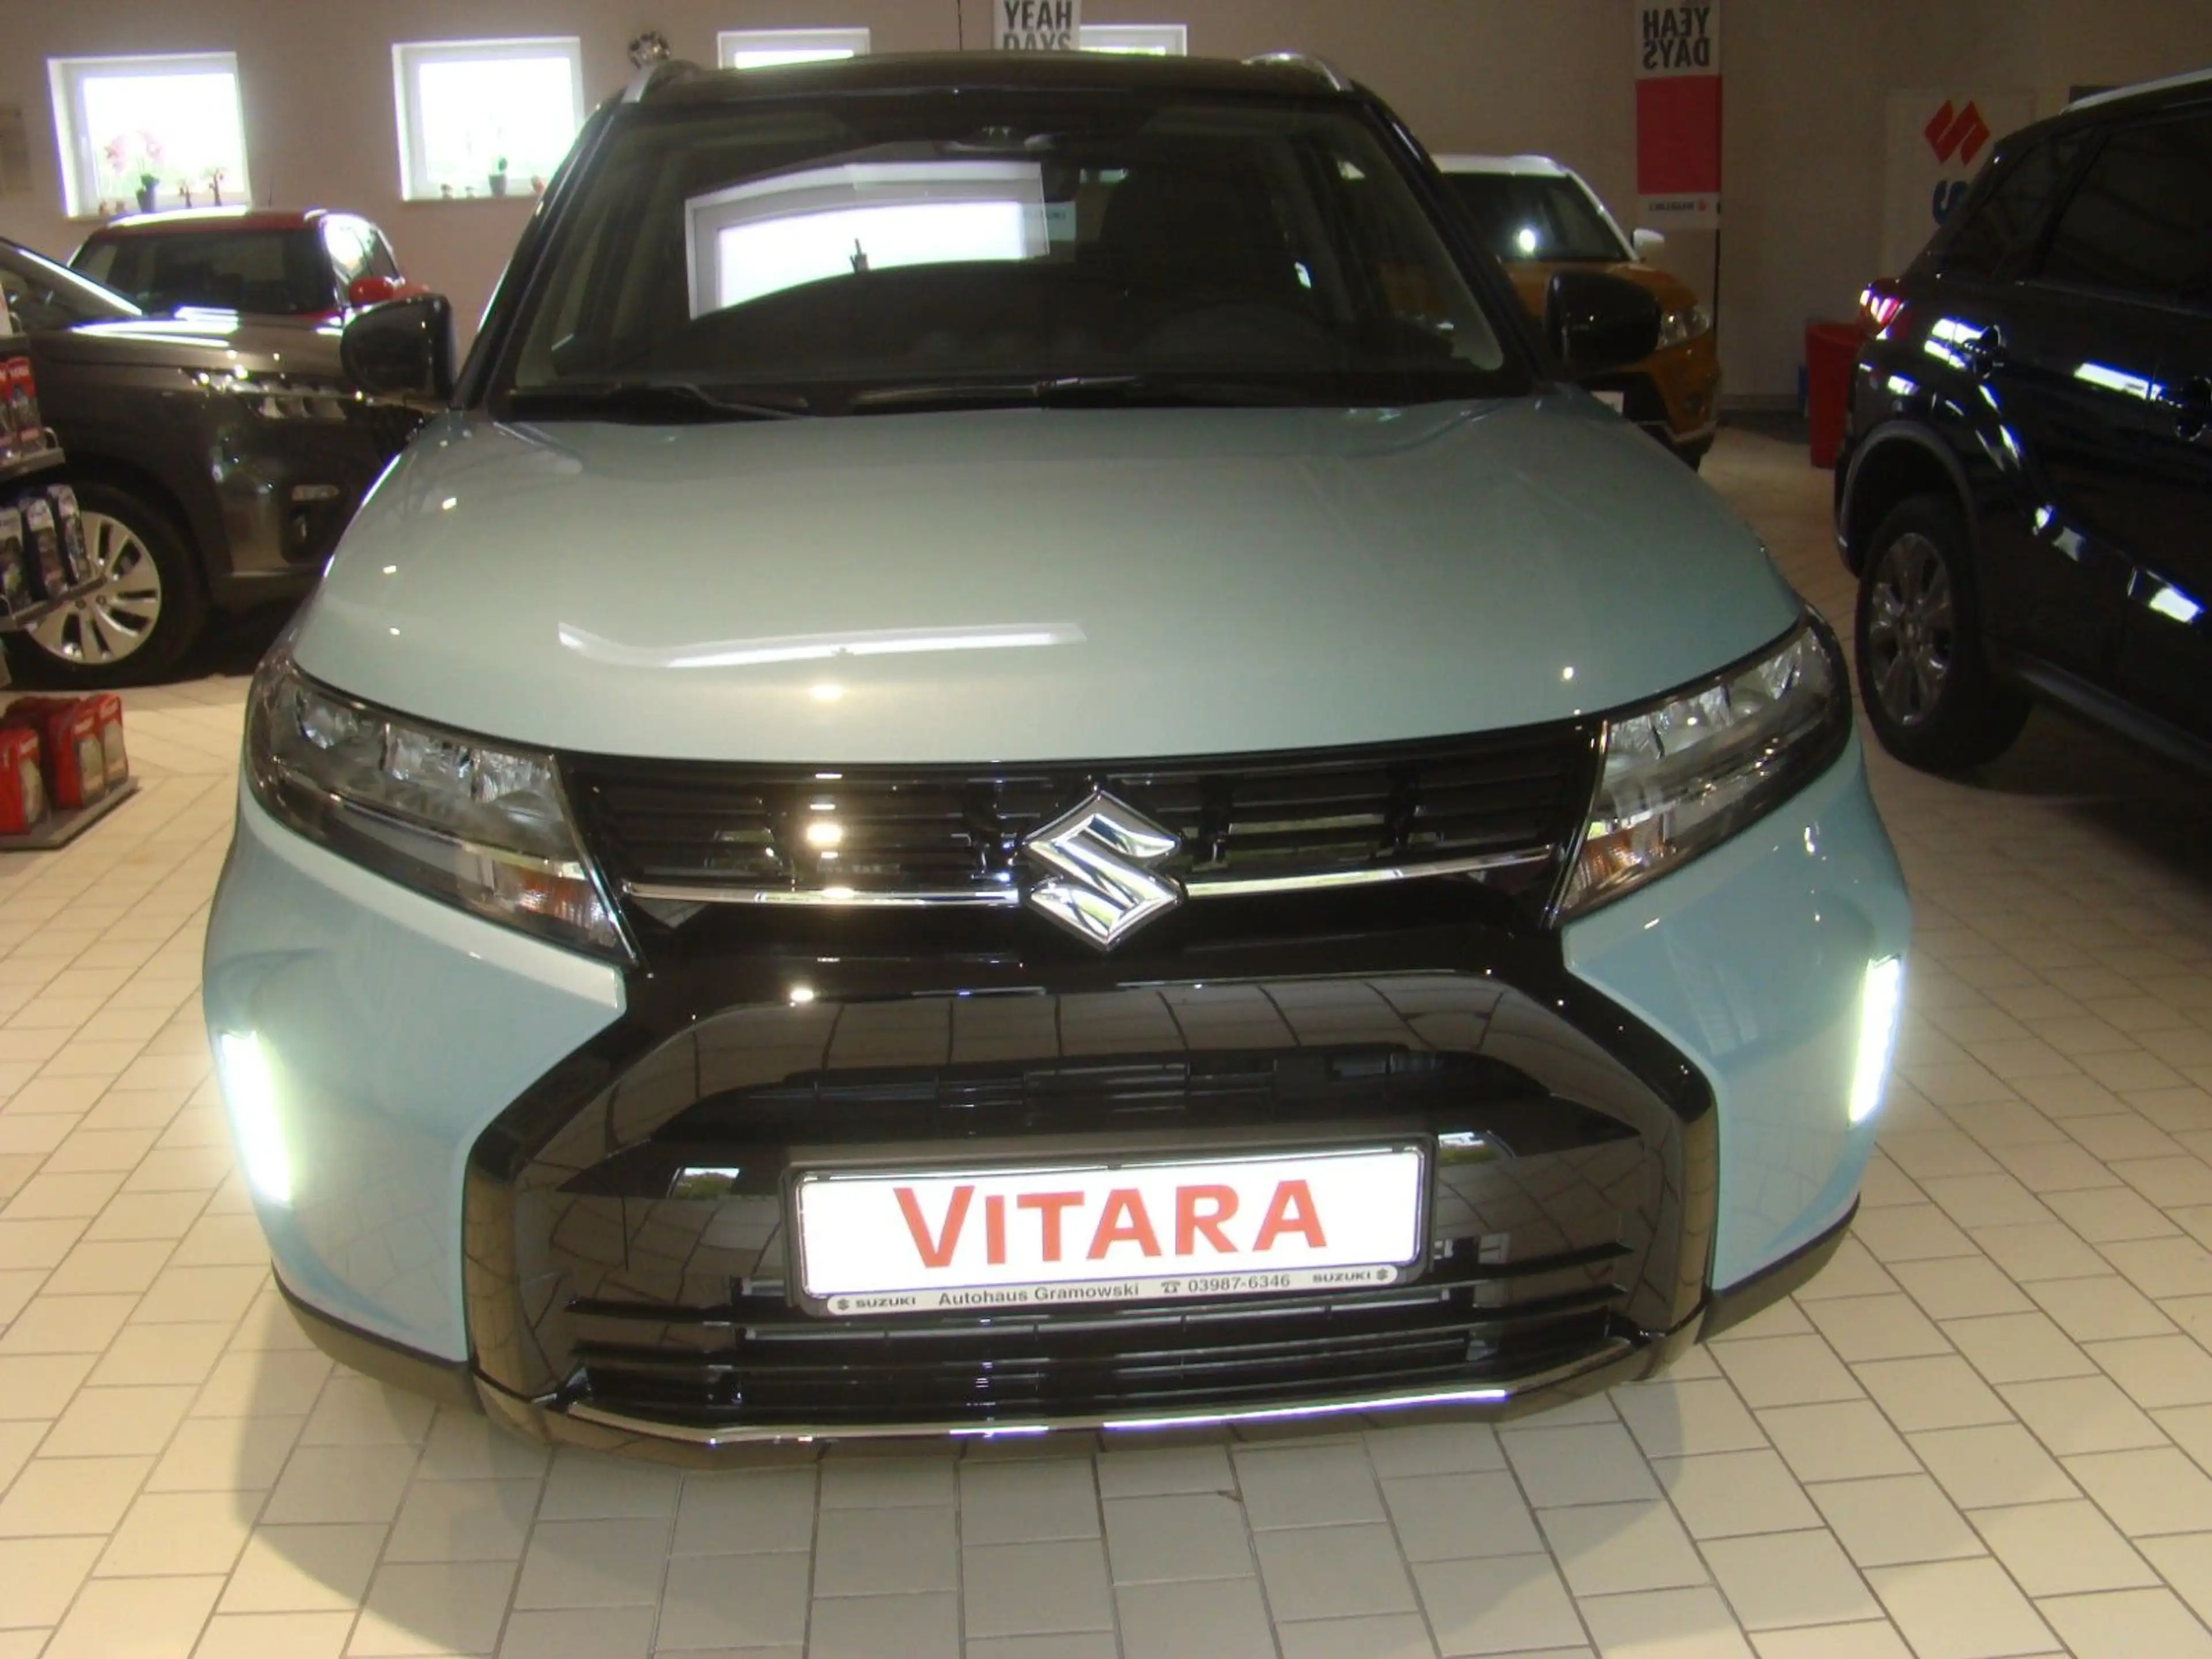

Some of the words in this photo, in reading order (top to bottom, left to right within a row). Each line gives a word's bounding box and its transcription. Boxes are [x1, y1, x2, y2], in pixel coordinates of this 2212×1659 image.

[1004, 0, 1073, 31] YEAH
[892, 1179, 1328, 1268] VITARA
[855, 1296, 916, 1309] SUZUKI
[938, 1289, 1028, 1306] Autohaus
[1034, 1282, 1139, 1301] Gramowski
[1188, 1274, 1290, 1293] 03987-6346
[1312, 1270, 1371, 1283] SUZUKI
